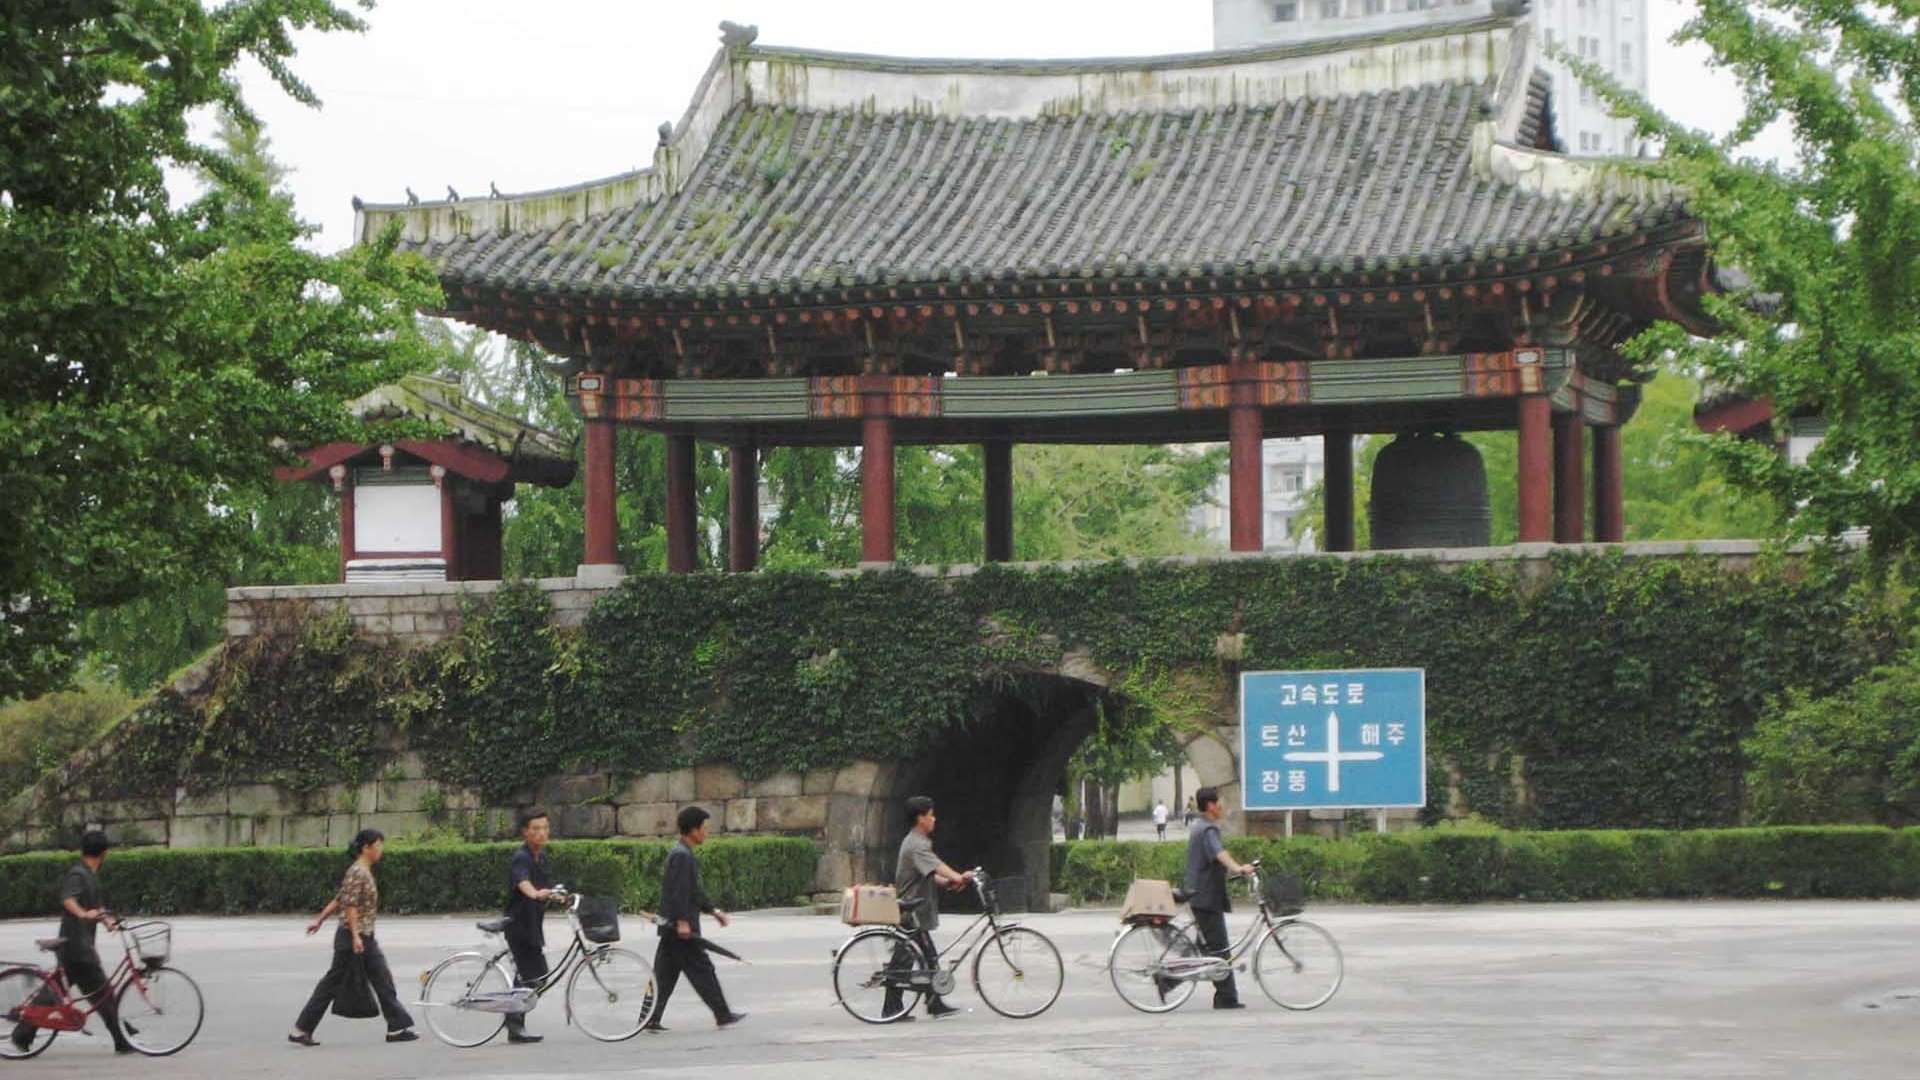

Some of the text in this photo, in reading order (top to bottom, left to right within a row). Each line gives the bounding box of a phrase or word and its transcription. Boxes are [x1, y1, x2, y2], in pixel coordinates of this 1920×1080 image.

[1280, 682, 1364, 706] 고속도로
[1261, 724, 1307, 747] 토산
[1361, 723, 1405, 746] 해주
[1261, 769, 1306, 793] 장풍
